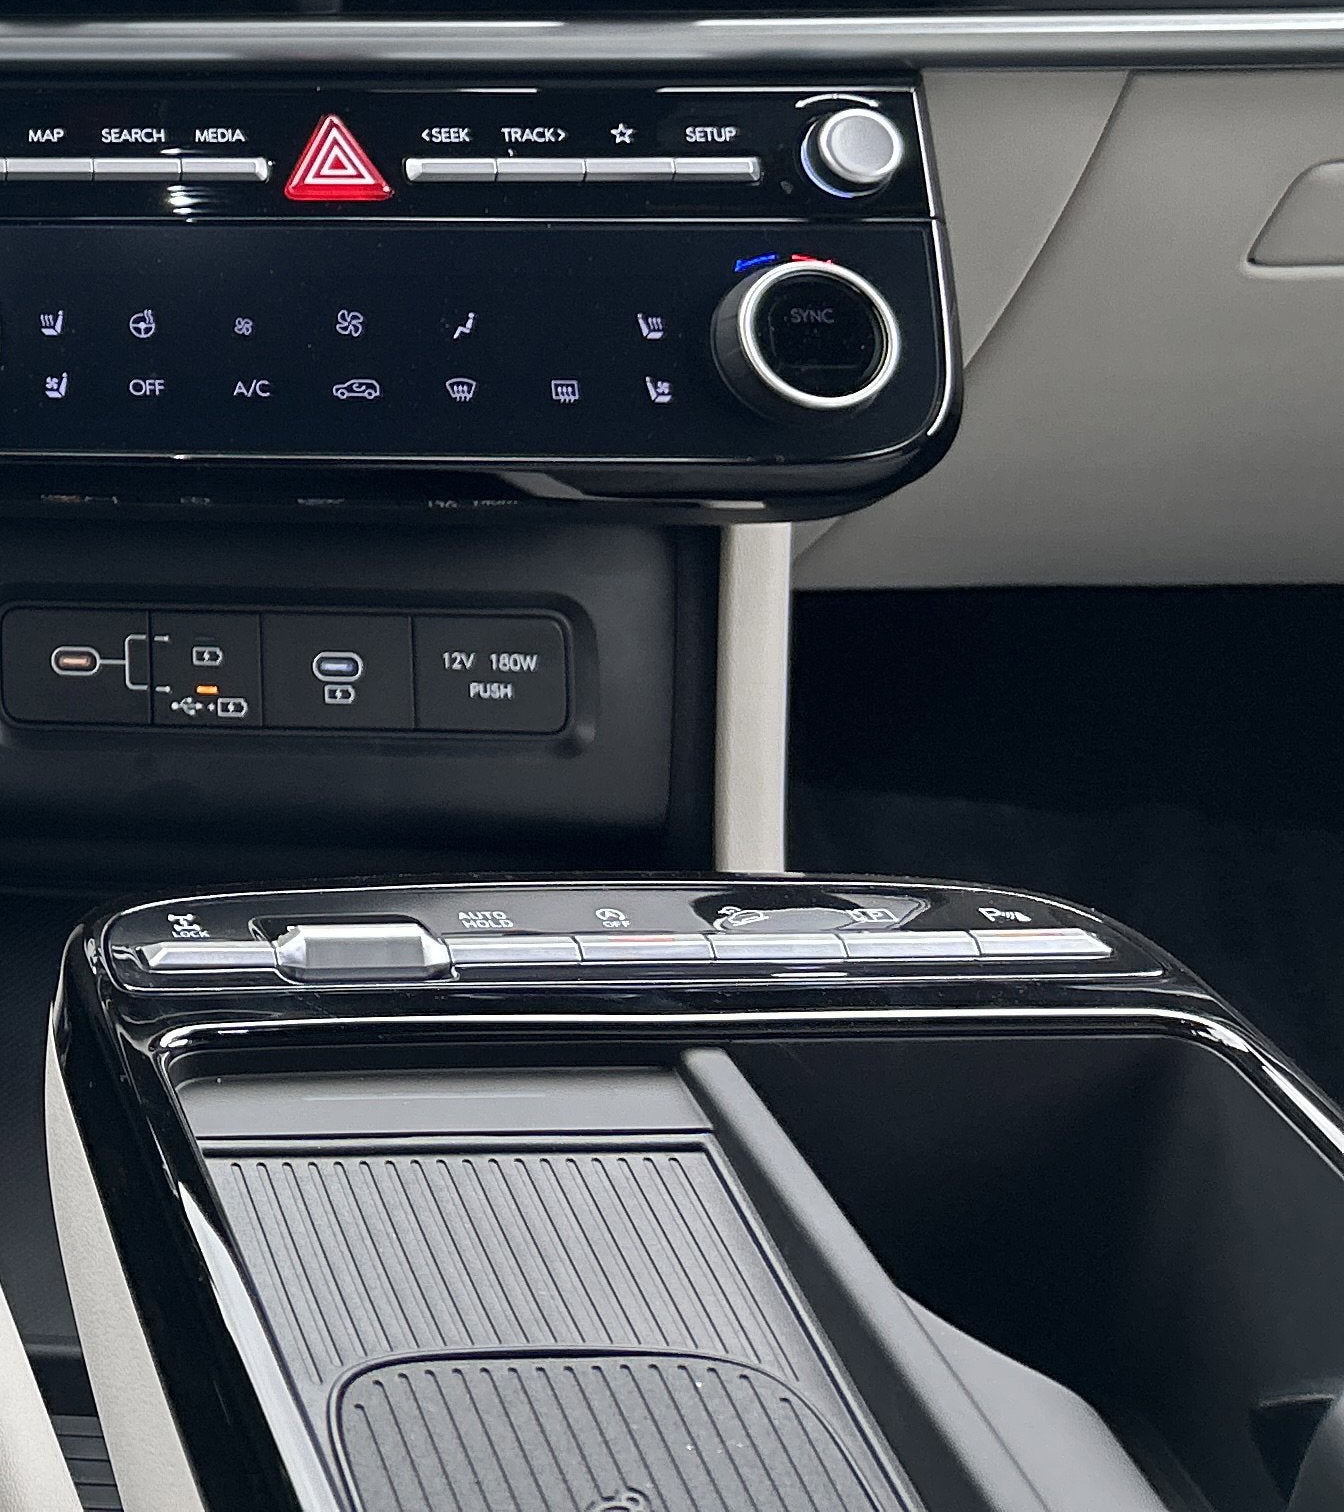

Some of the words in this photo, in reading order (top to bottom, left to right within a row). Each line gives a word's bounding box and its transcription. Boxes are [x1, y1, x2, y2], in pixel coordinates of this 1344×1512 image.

[29, 129, 64, 142] MAP
[102, 128, 165, 142] SEARCH
[196, 128, 245, 142] MEDIA
[686, 128, 736, 142] SETUP
[790, 308, 834, 324] SYNC
[129, 380, 164, 395] OFF
[234, 380, 270, 397] A/C
[444, 652, 475, 669] 12V
[491, 654, 537, 671] 180W
[470, 683, 512, 698] PUSH
[458, 912, 505, 920] AUTO
[463, 919, 513, 928] HOLD
